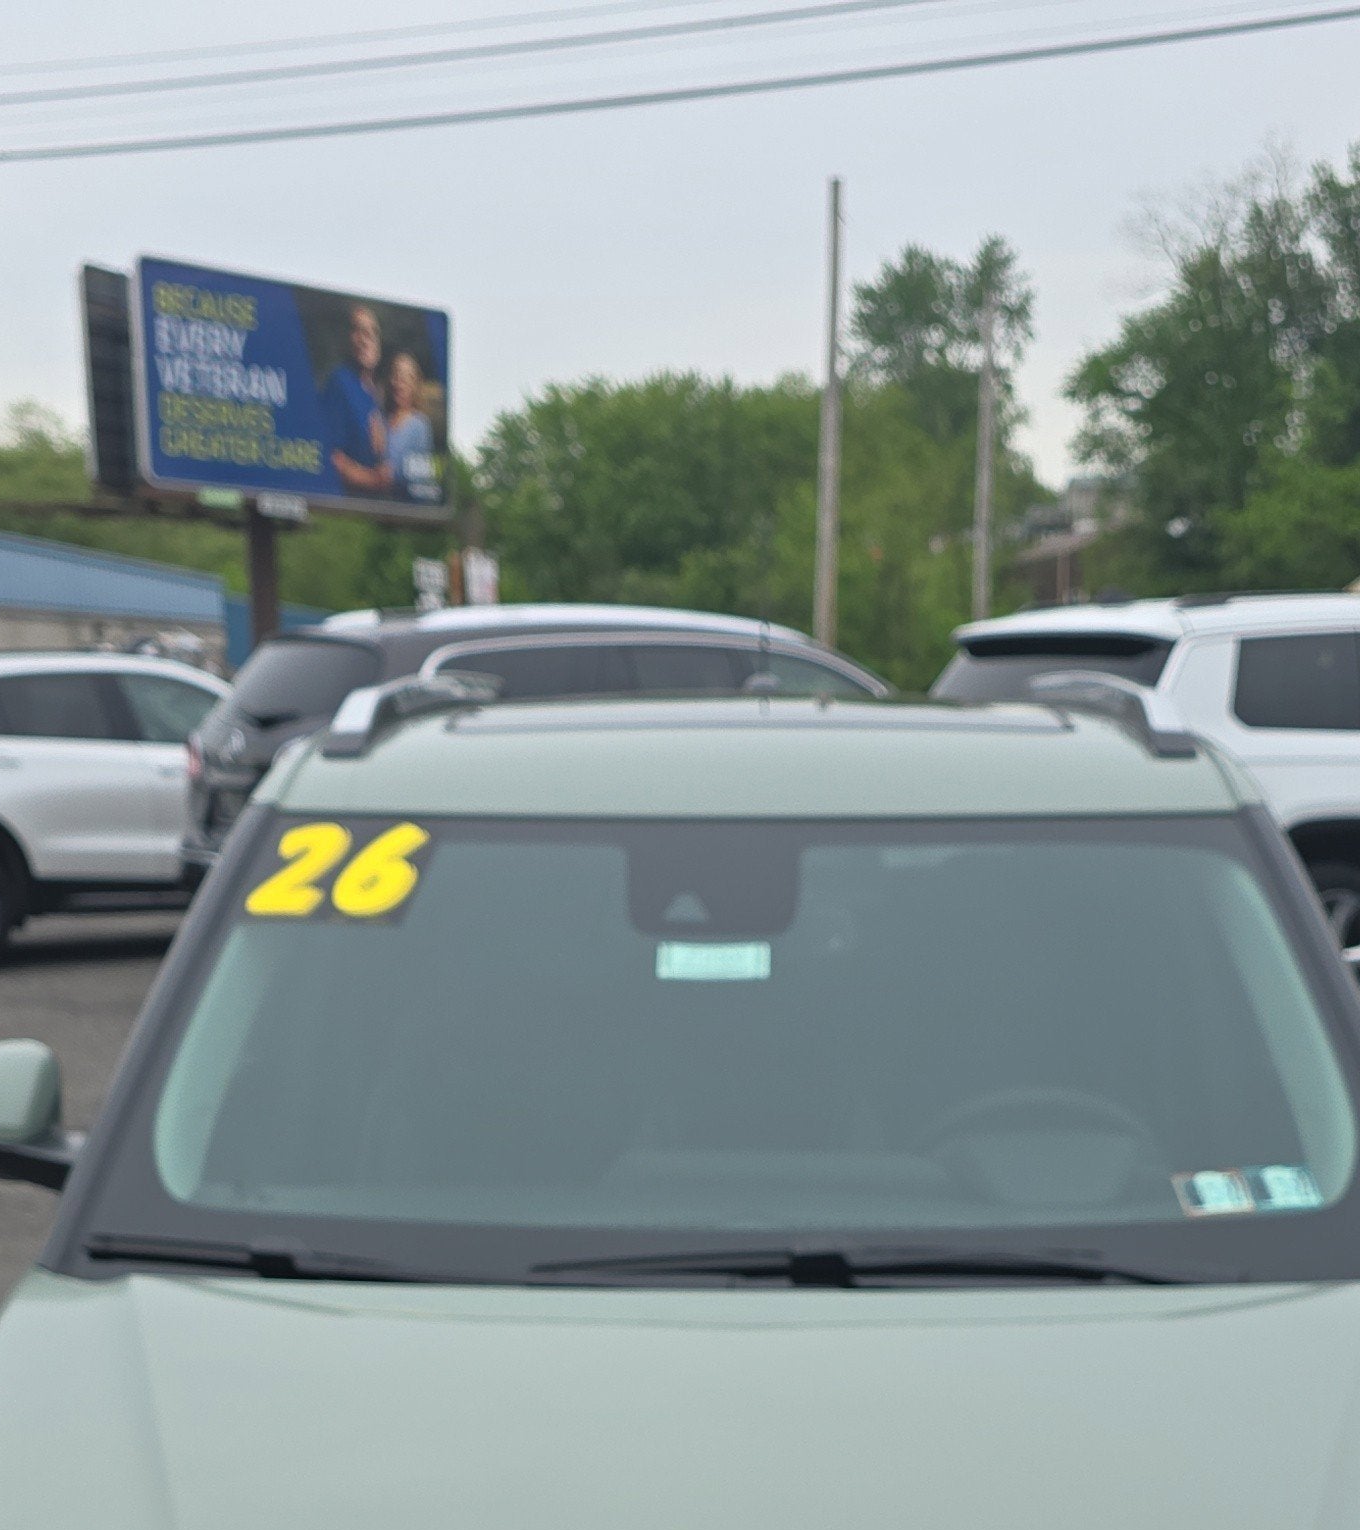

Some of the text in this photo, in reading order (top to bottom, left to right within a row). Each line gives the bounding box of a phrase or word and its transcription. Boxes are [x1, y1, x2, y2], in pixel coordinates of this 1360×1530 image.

[154, 315, 248, 359] EVERY
[154, 353, 288, 407] VETERAN
[244, 821, 431, 918] 26
